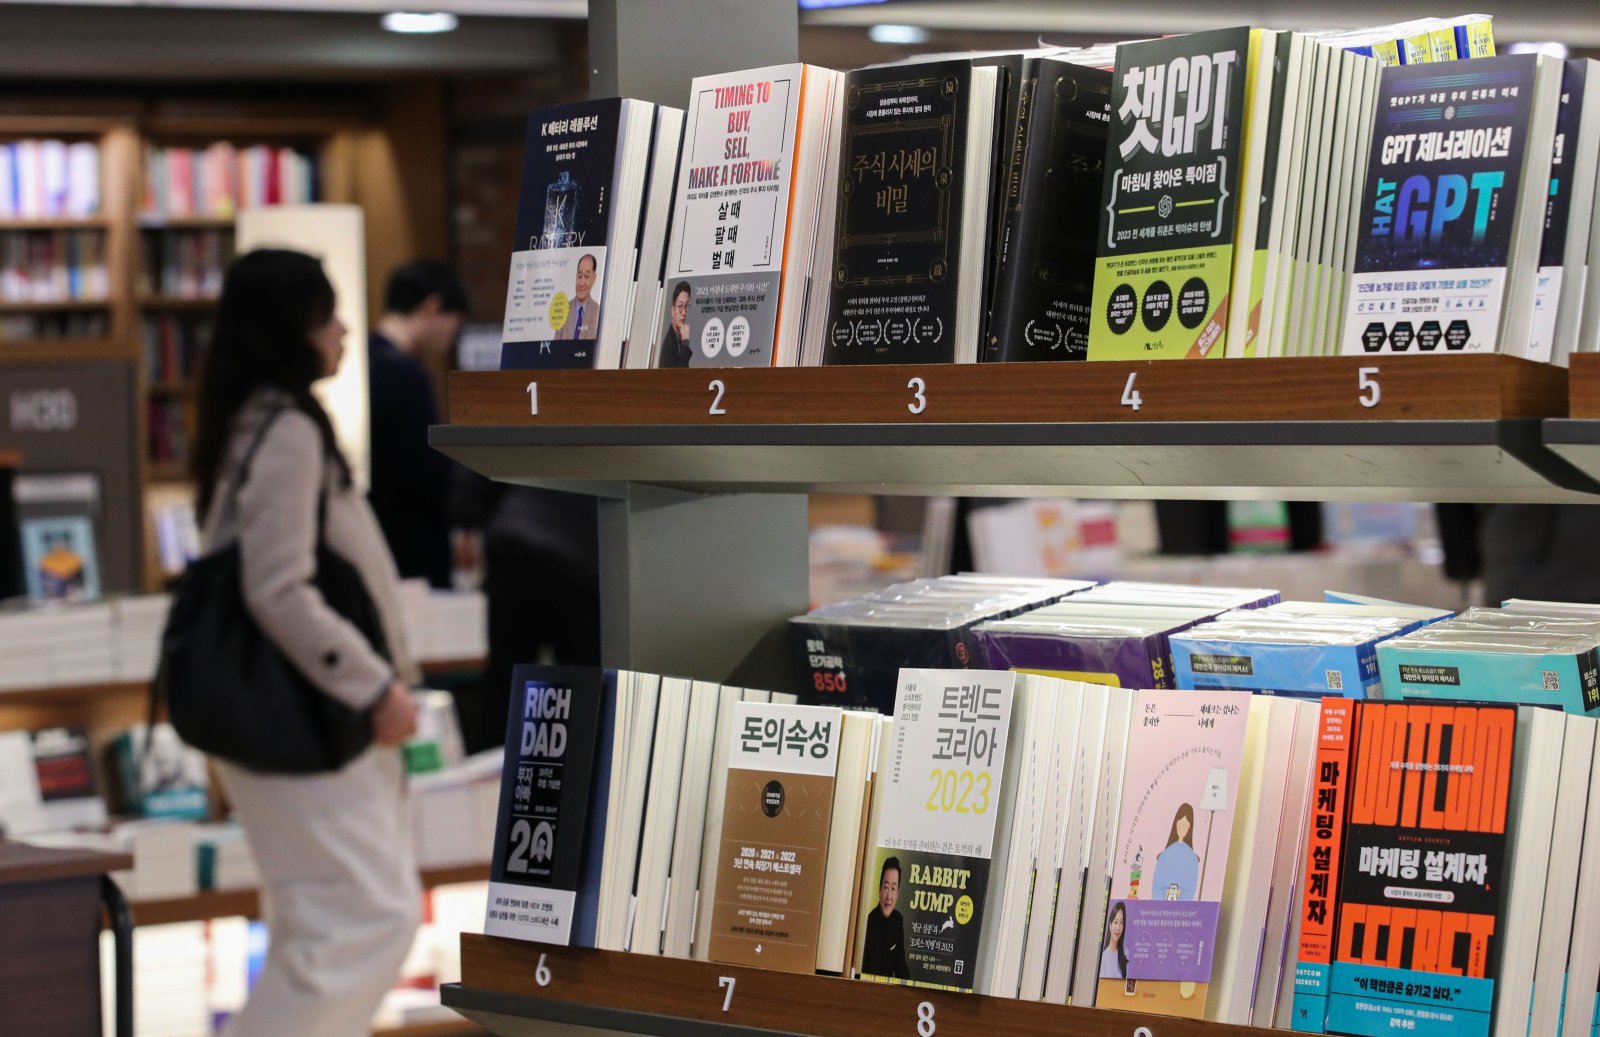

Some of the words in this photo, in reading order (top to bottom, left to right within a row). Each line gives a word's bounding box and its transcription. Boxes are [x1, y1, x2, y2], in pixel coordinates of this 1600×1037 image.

[715, 83, 754, 109] TIMING
[757, 80, 770, 104] TO
[1118, 50, 1236, 158] 챗GPT
[1390, 95, 1426, 107] 챗GPT가
[1430, 92, 1446, 103] 바꿀
[1450, 91, 1466, 102] 우리
[1472, 88, 1496, 100] 인류의
[1501, 86, 1518, 98] 미래
[542, 123, 548, 136] K
[548, 118, 568, 136] 배터리
[570, 115, 598, 133] 레볼루션
[728, 110, 750, 134] BUY,
[724, 136, 750, 160] SELL,
[1381, 134, 1416, 165] GPT
[1416, 126, 1512, 162] 제너레이션
[688, 166, 720, 190] MAKE
[720, 164, 728, 186] A
[730, 159, 780, 185] FORTUNE
[853, 152, 886, 182] 주식
[888, 147, 937, 179] 시세의
[1121, 172, 1151, 193] 마침내
[1153, 168, 1182, 189] 찾아온
[1185, 163, 1217, 184] 특이점
[718, 202, 728, 220] 살
[730, 200, 741, 219] 때
[876, 184, 908, 216] 비밀
[1393, 171, 1506, 247] GPT
[715, 226, 725, 245] 팔
[728, 224, 738, 244] 때
[1117, 230, 1130, 240] 2023
[1132, 228, 1138, 240] 전
[1139, 226, 1156, 238] 세계를
[1157, 225, 1174, 236] 뒤흔든
[1175, 222, 1198, 234] 빅이슈의
[1200, 220, 1212, 232] 탄생
[712, 250, 722, 270] 벌
[724, 250, 735, 268] 때
[527, 382, 537, 414] 1
[709, 380, 725, 414] 2
[908, 377, 926, 414] 3
[1121, 373, 1142, 410] 4
[1359, 367, 1380, 407] 5
[524, 688, 572, 720] RICH
[938, 684, 1002, 722] 트렌드
[1145, 704, 1156, 714] 돈은
[1200, 704, 1222, 714] 재테크는
[1223, 704, 1240, 716] 겁나는
[1588, 689, 1599, 702] 1위
[1143, 717, 1160, 728] 좋지만
[1198, 718, 1214, 728] 나에게
[520, 722, 567, 758] DAD
[932, 726, 997, 767] 코리아
[518, 766, 533, 781] 부자
[516, 784, 532, 802] 아빠
[926, 768, 992, 815] 2023
[1316, 761, 1339, 840] 마케팅
[734, 858, 742, 868] 3년
[743, 860, 754, 870] 연속
[755, 861, 772, 872] 최장기
[772, 863, 802, 876] 베스트셀러
[741, 847, 756, 858] 2020
[760, 849, 774, 860] 2021
[781, 852, 796, 862] 2022
[1359, 846, 1420, 880] 마케팅
[1424, 851, 1488, 885] 설계자
[910, 864, 970, 890] RABBIT
[1308, 846, 1331, 925] 설계자
[910, 890, 954, 914] JUMP
[536, 954, 550, 986] 6
[719, 977, 735, 1011] 7
[1370, 978, 1404, 994] 책만큼은
[1405, 982, 1432, 998] 숨기고
[918, 1002, 935, 1037] 8
